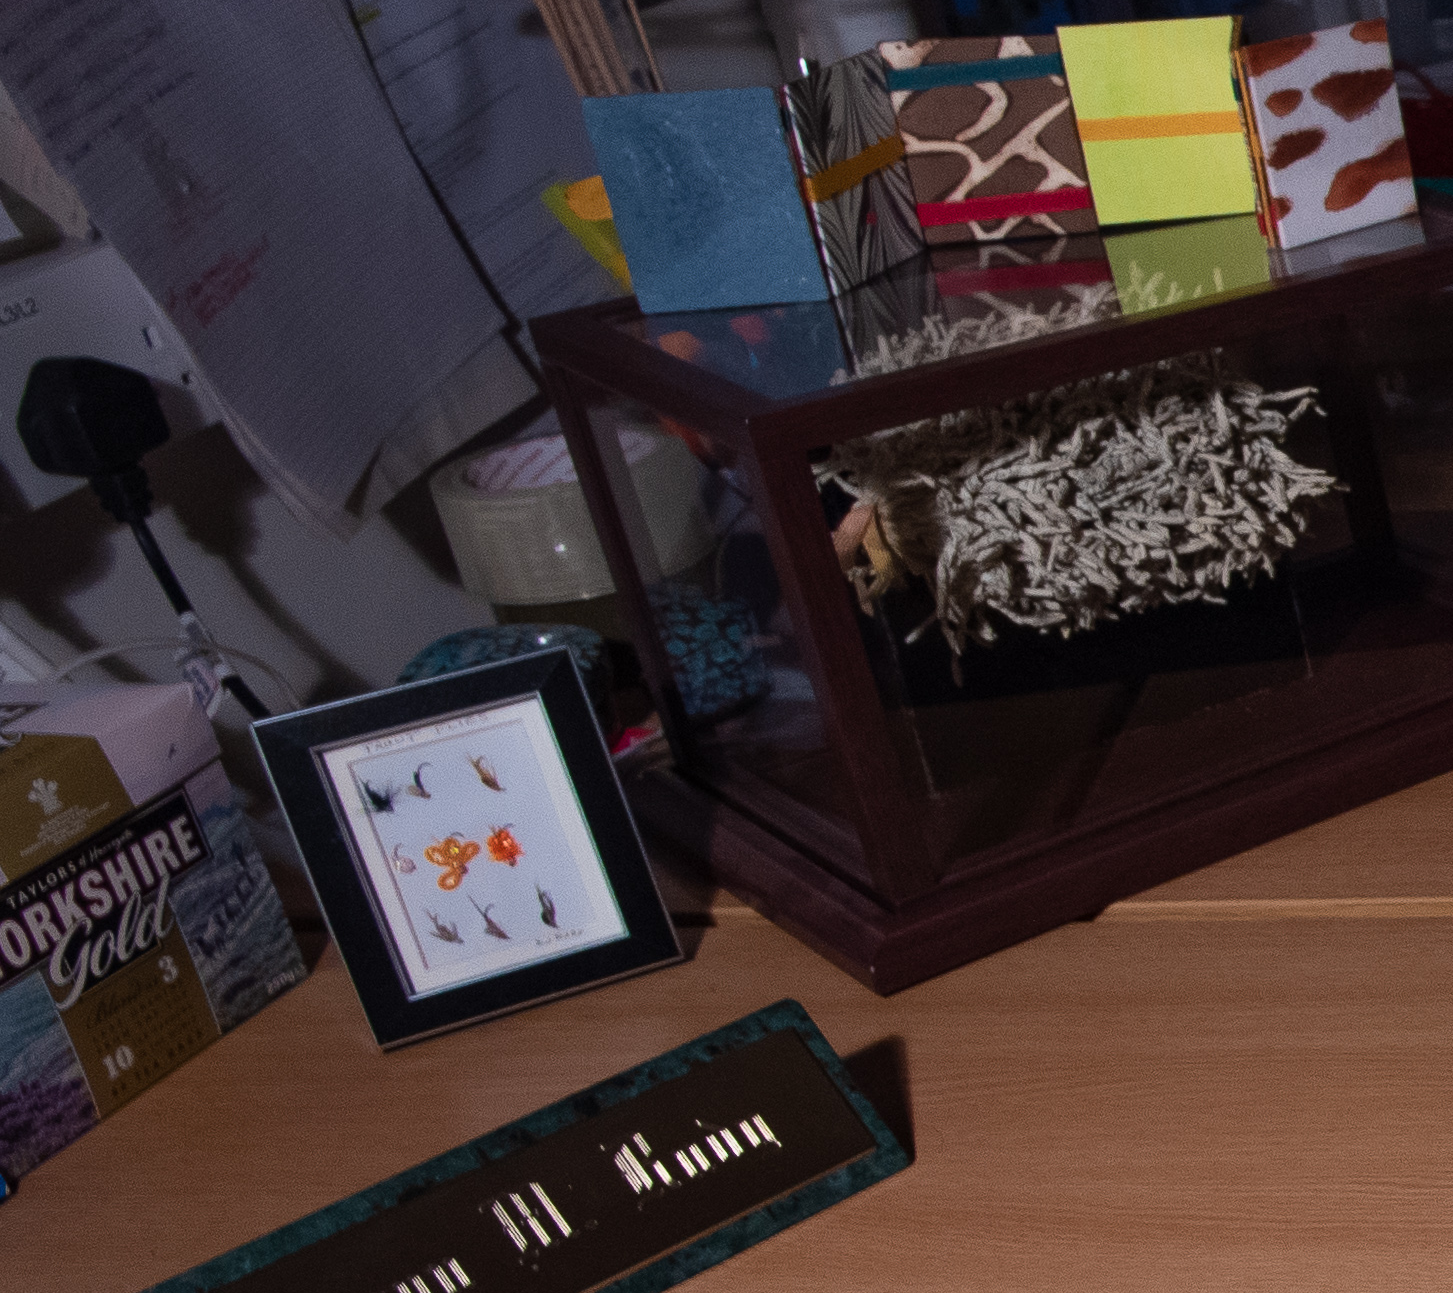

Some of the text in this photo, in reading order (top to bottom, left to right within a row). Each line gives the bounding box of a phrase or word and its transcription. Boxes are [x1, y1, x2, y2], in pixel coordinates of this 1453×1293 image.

[0, 814, 202, 985] ORKSHIRE
[50, 887, 176, 1011] Gold
[102, 1044, 135, 1082] 10
